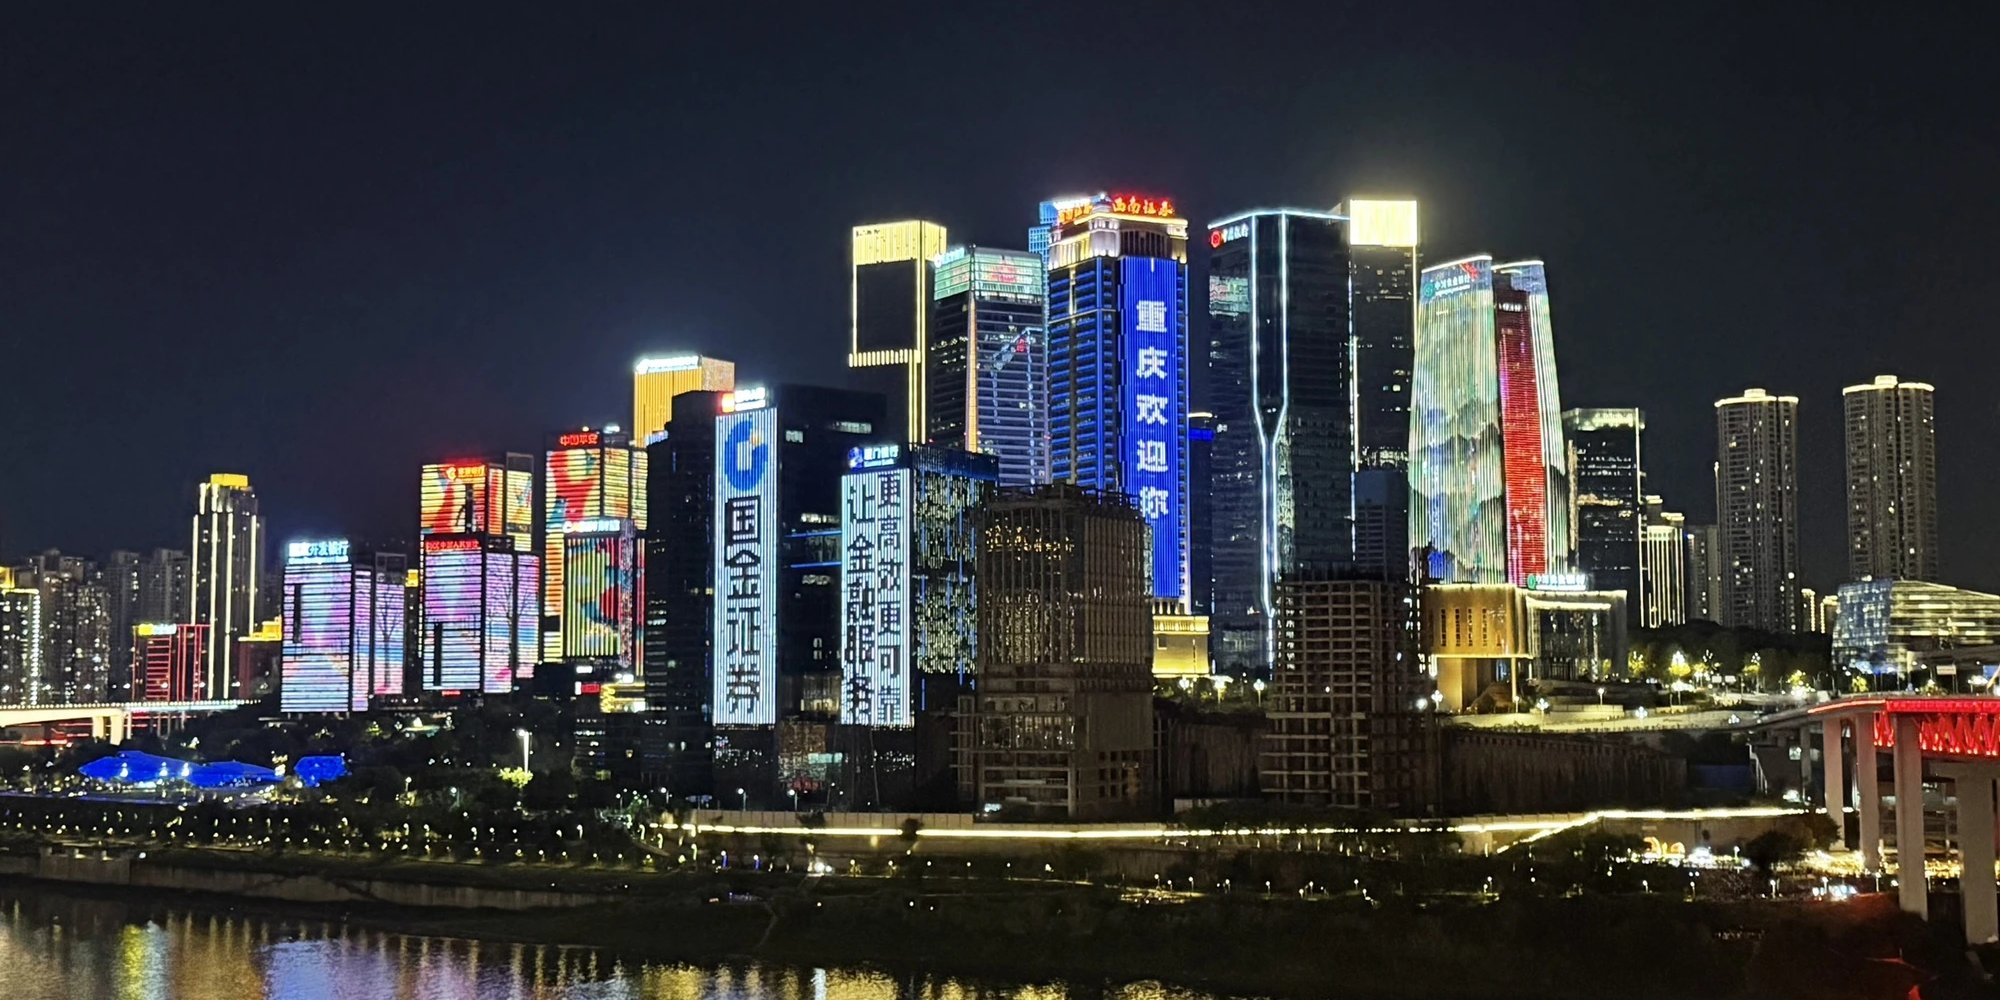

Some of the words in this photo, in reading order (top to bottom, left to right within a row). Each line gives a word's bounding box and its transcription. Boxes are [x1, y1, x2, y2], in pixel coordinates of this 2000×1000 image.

[560, 434, 598, 446] 中国平安
[1137, 300, 1168, 520] 重庆欢迎你
[288, 541, 350, 557] 开发银行
[725, 496, 760, 714] 国金证券
[845, 484, 875, 724] 让金融服务
[878, 474, 901, 724] 更高效更可靠
